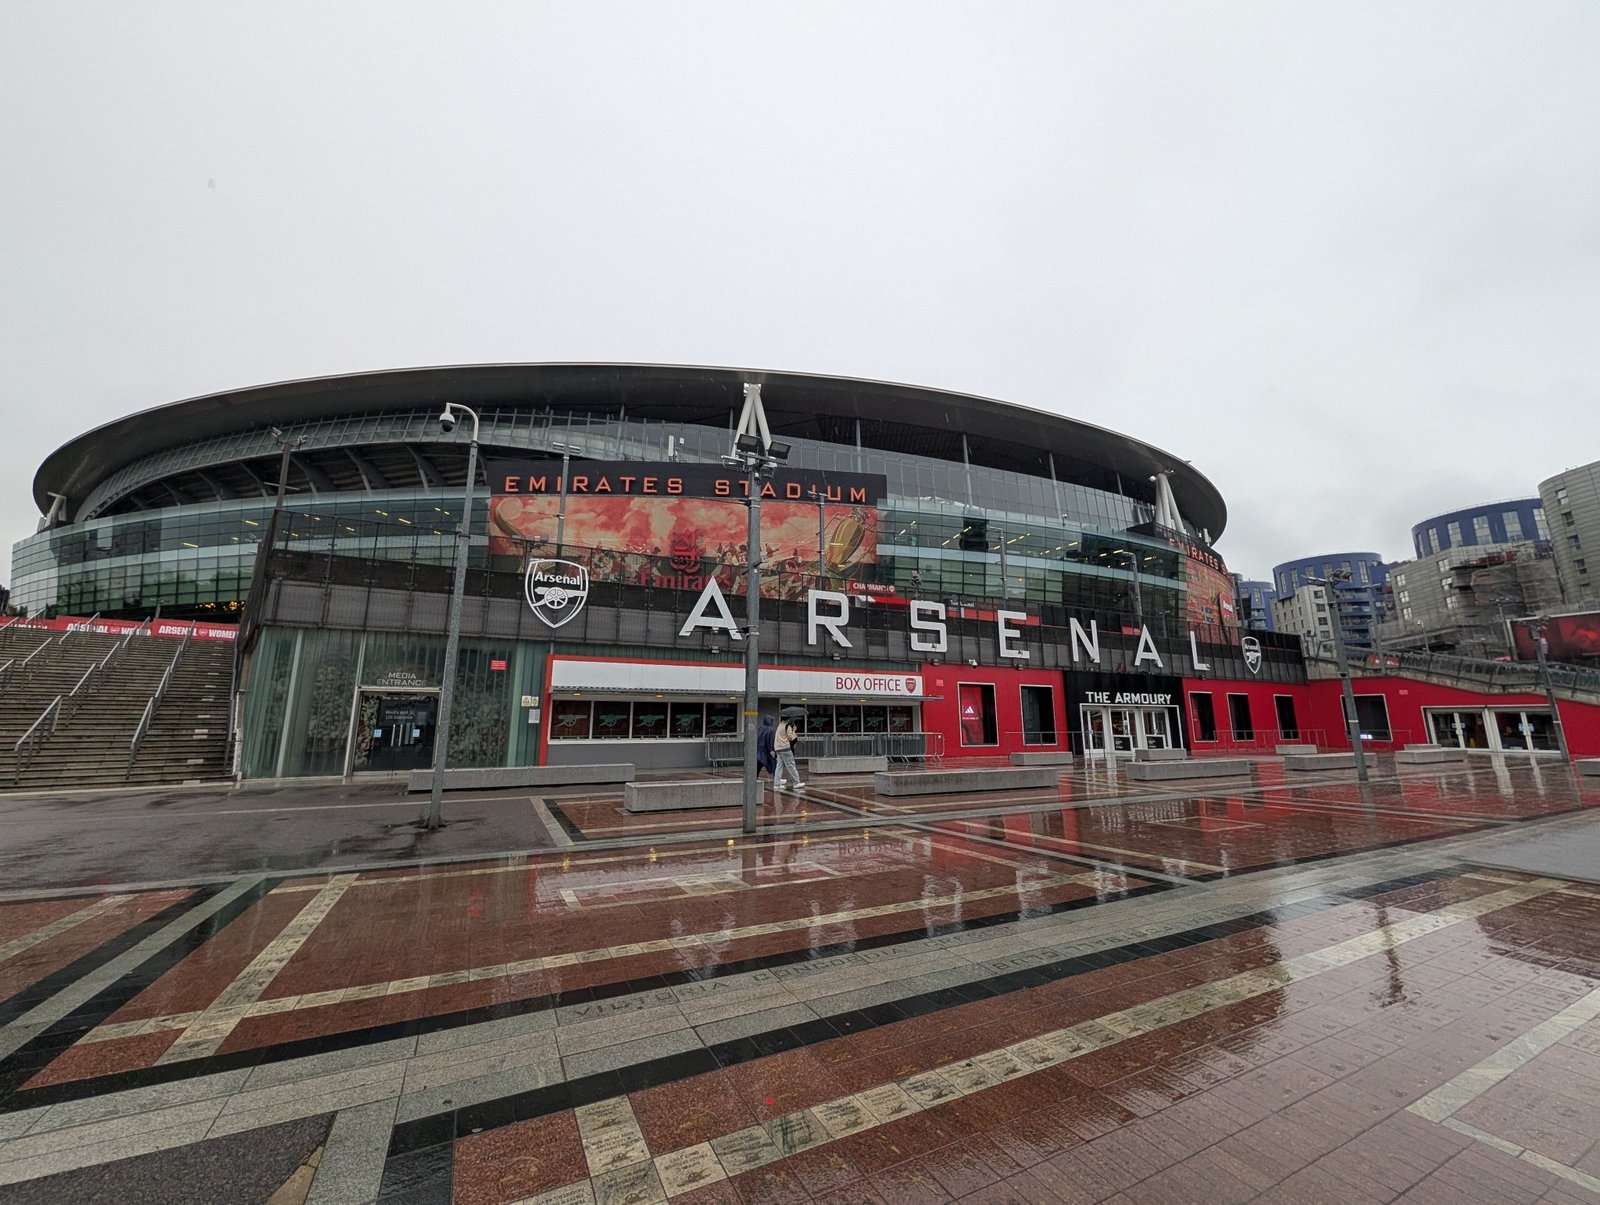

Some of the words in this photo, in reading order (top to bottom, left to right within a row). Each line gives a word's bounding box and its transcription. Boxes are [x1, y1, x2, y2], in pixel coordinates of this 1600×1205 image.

[505, 475, 683, 494] EMIRATES
[714, 479, 866, 503] STADIUM
[534, 571, 581, 586] Arsenal
[678, 575, 1211, 672] ARSENAL
[376, 678, 426, 686] ENTRANCE
[836, 676, 861, 691] BOX
[863, 677, 902, 692] OFFICE
[1084, 691, 1111, 704] THE
[1114, 691, 1172, 705] ARMOURY
[991, 948, 1060, 971] CLUB
